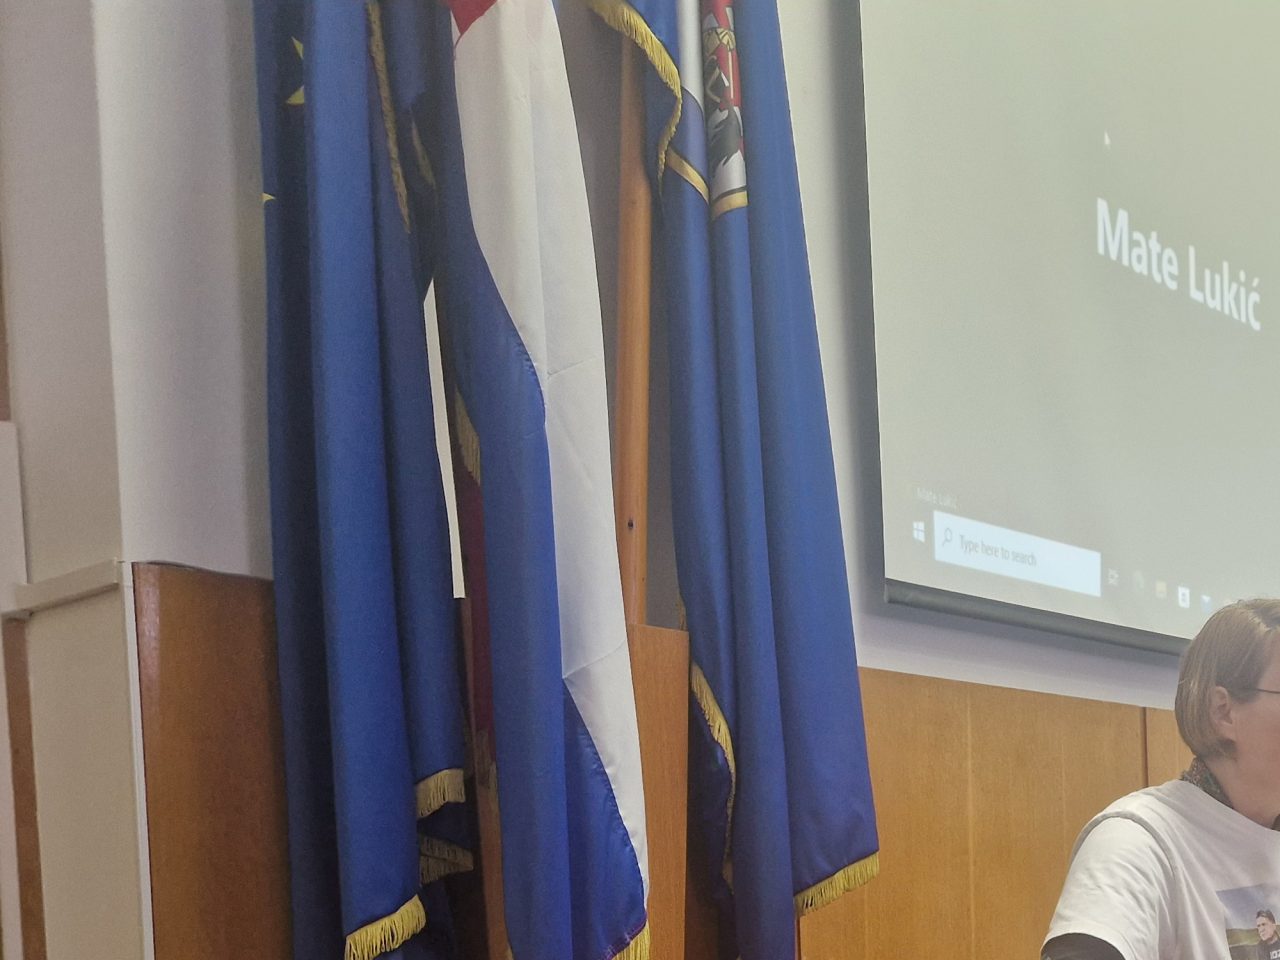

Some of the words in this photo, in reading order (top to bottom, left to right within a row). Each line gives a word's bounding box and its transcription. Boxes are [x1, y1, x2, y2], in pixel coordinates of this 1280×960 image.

[1097, 197, 1179, 290] Mate
[1188, 245, 1261, 331] Lukić
[960, 534, 979, 555] Type
[981, 540, 999, 558] here
[1000, 546, 1010, 561] to
[1011, 550, 1037, 567] search
